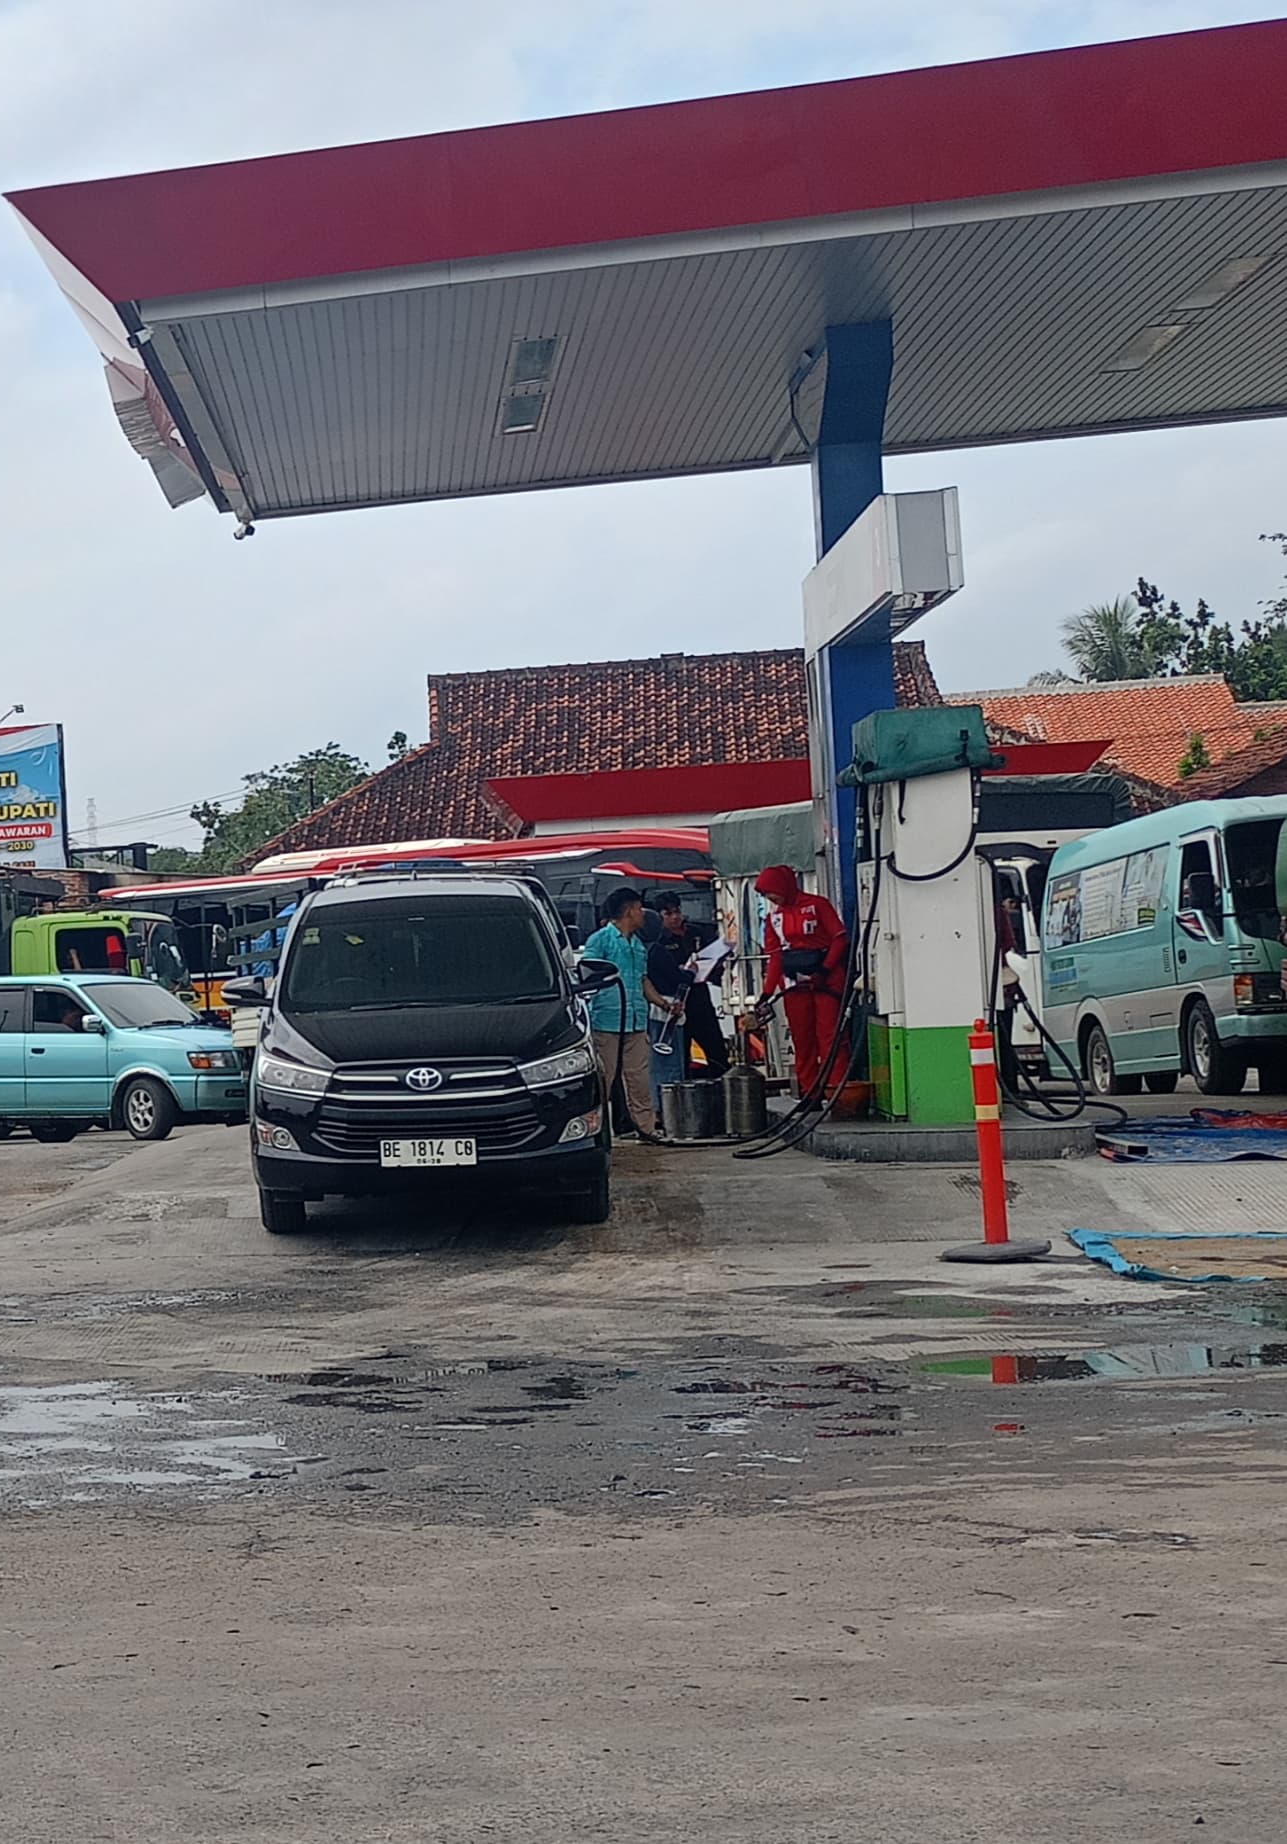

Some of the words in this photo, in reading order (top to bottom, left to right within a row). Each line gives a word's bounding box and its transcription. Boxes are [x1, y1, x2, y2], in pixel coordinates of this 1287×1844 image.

[7, 841, 34, 851] 2030
[383, 1142, 400, 1157] BE
[411, 1141, 444, 1157] 1814
